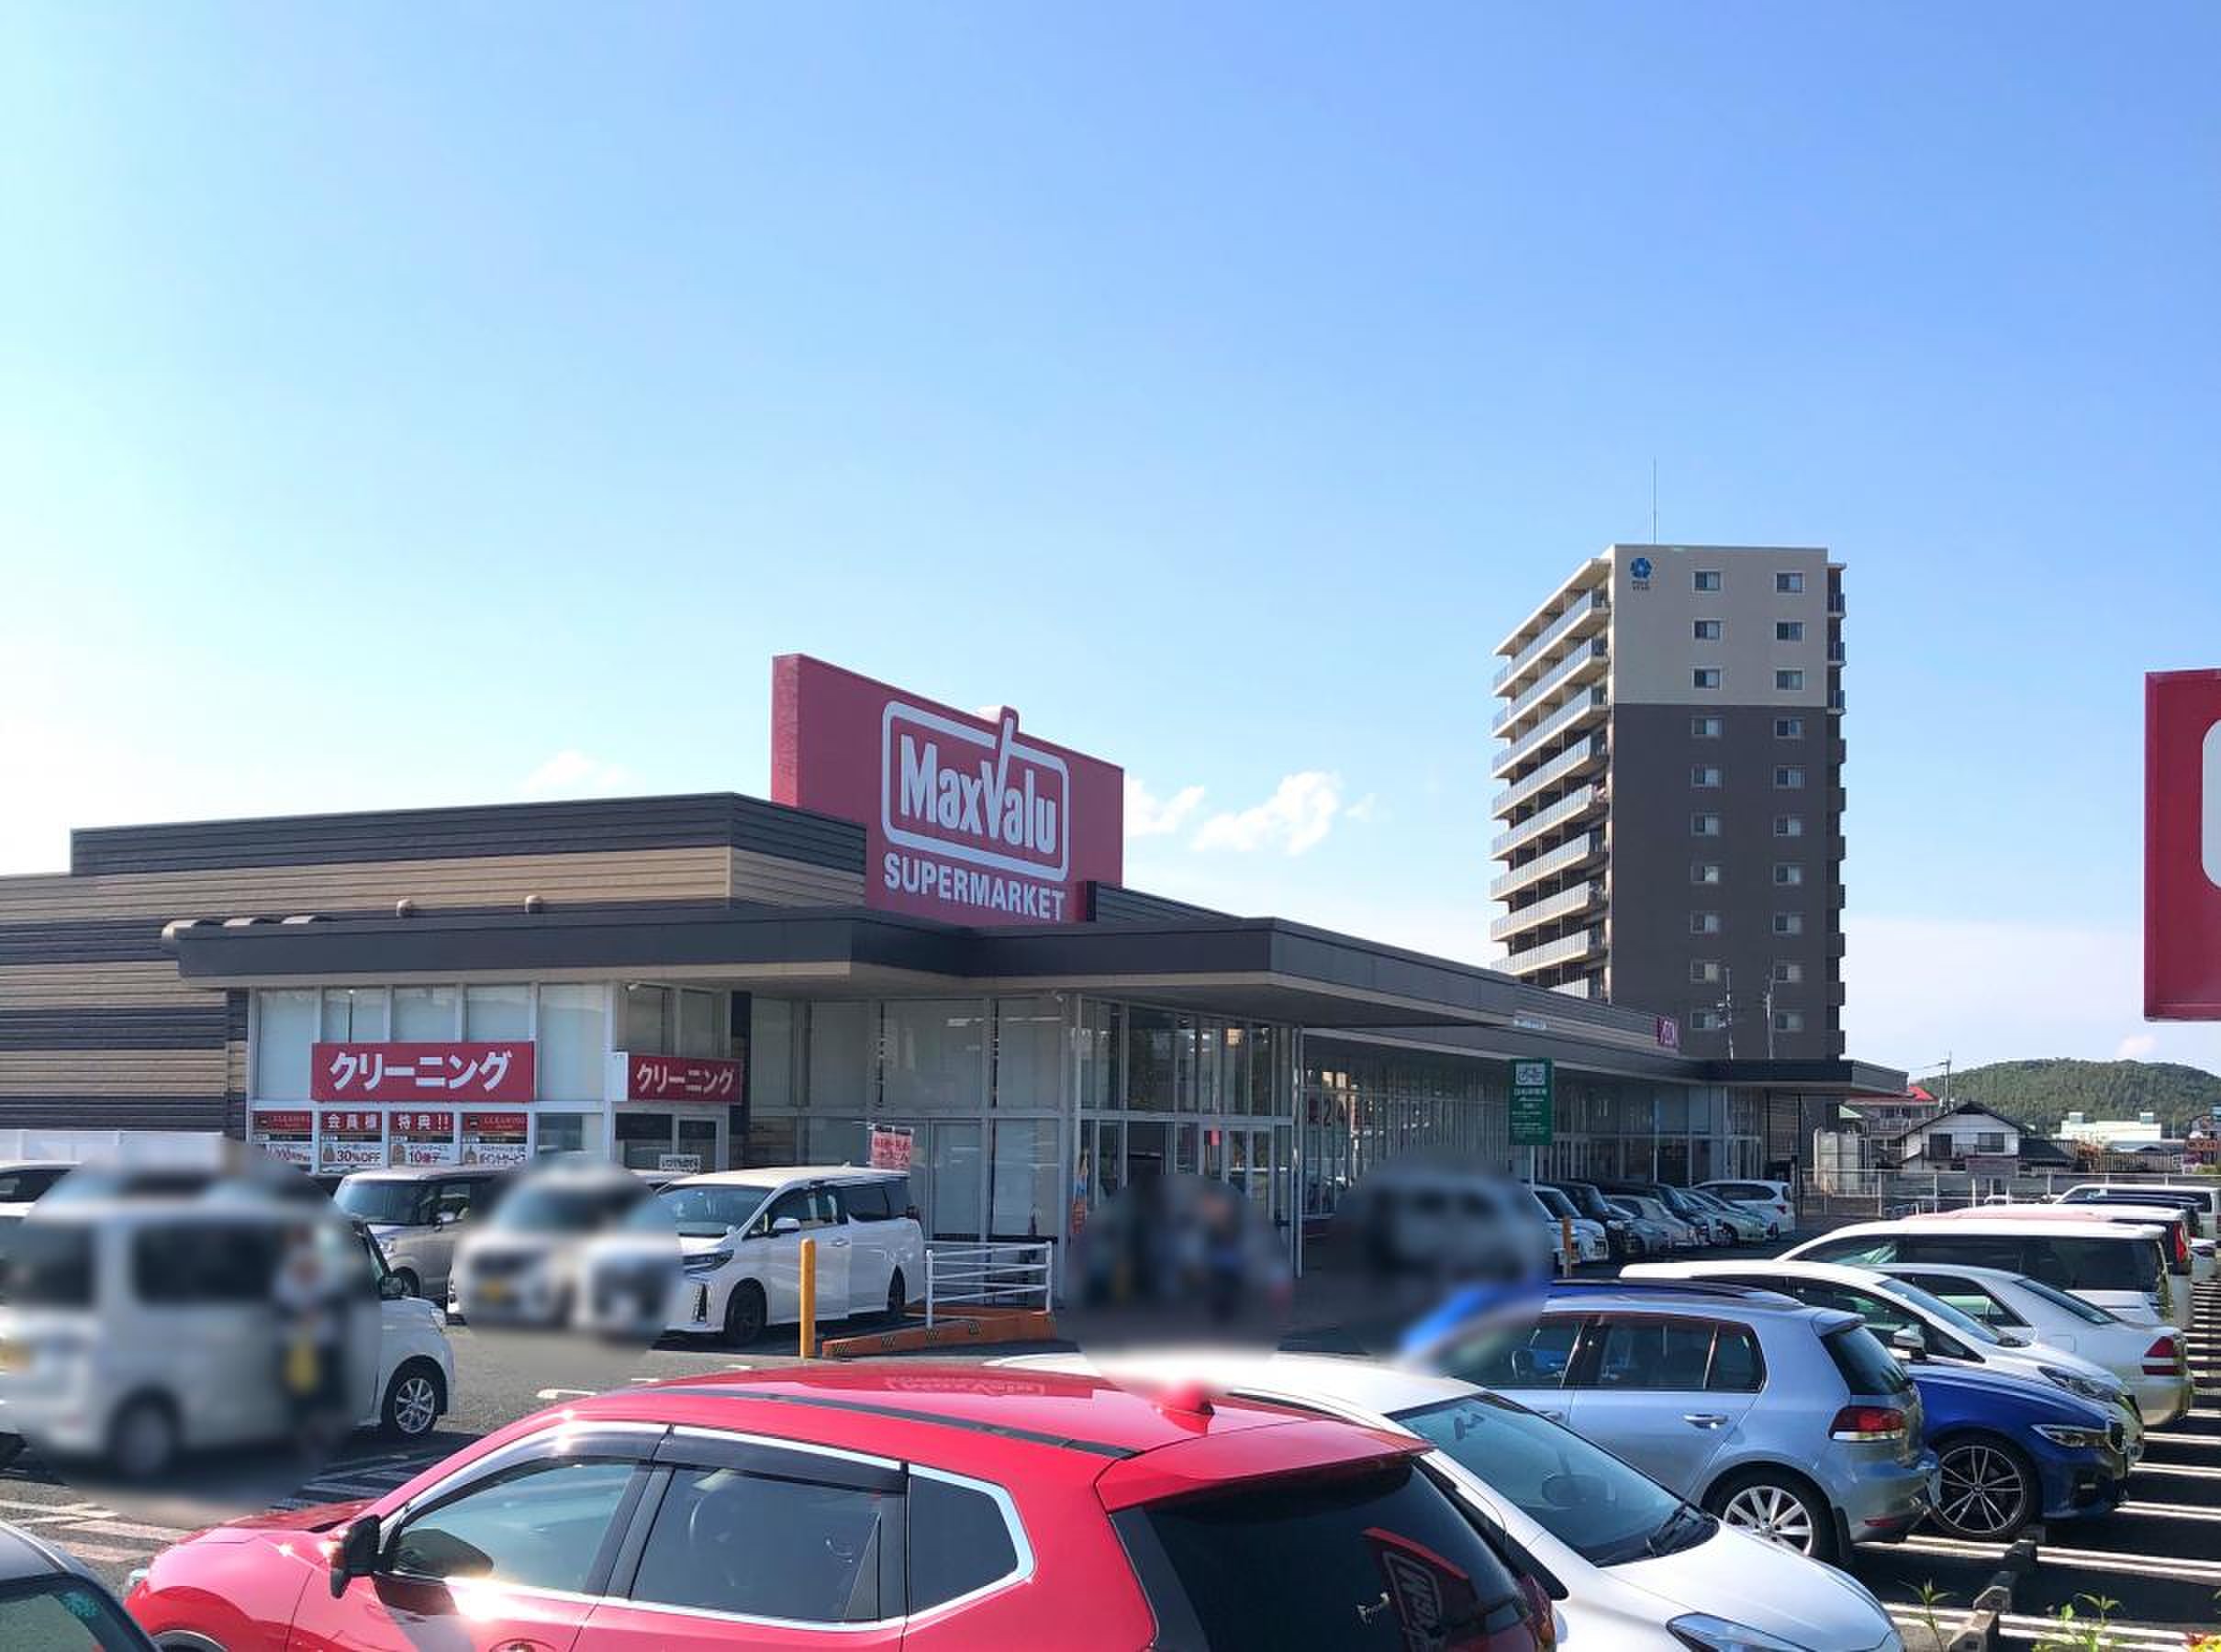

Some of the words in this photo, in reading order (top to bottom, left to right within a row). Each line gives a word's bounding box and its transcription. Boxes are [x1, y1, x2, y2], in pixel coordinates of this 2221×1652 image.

[899, 717, 1056, 854] MaxValu
[883, 852, 1066, 921] SUPERMARKET
[328, 1050, 514, 1092] クリーニング
[635, 1061, 735, 1095] クリーニング
[337, 1150, 382, 1163] 30%OFF
